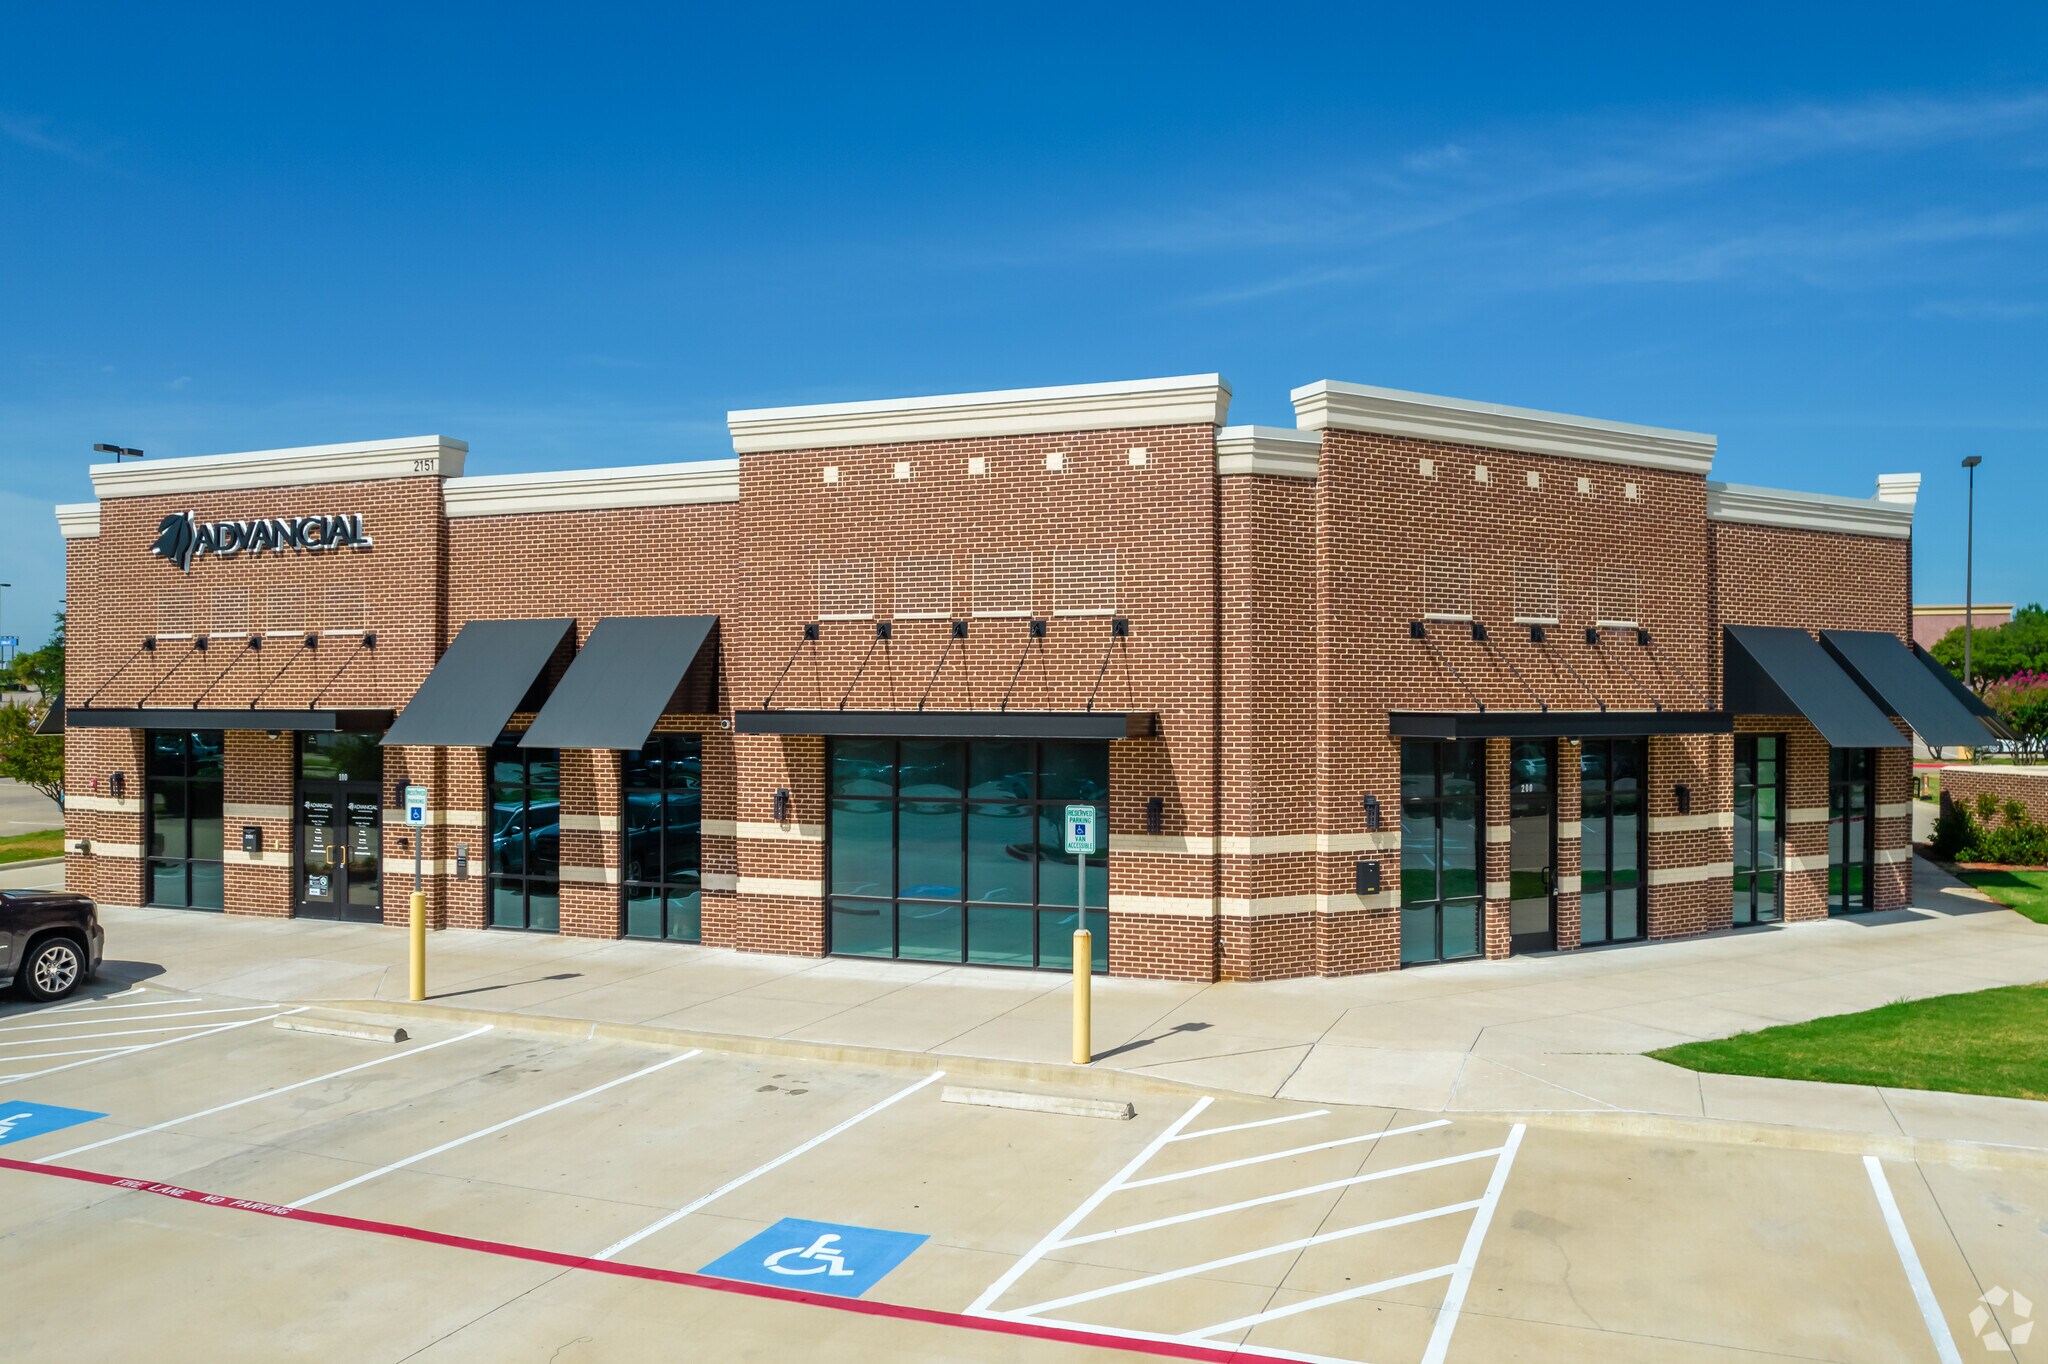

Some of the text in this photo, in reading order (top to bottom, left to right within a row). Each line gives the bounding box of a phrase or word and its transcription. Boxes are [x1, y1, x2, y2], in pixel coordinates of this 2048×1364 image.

[413, 459, 435, 472] 2151
[195, 513, 373, 555] ADVANCIAL
[338, 773, 348, 781] 100
[1520, 784, 1533, 793] 200
[112, 1178, 293, 1215] FIRE LANE NO PARKING
